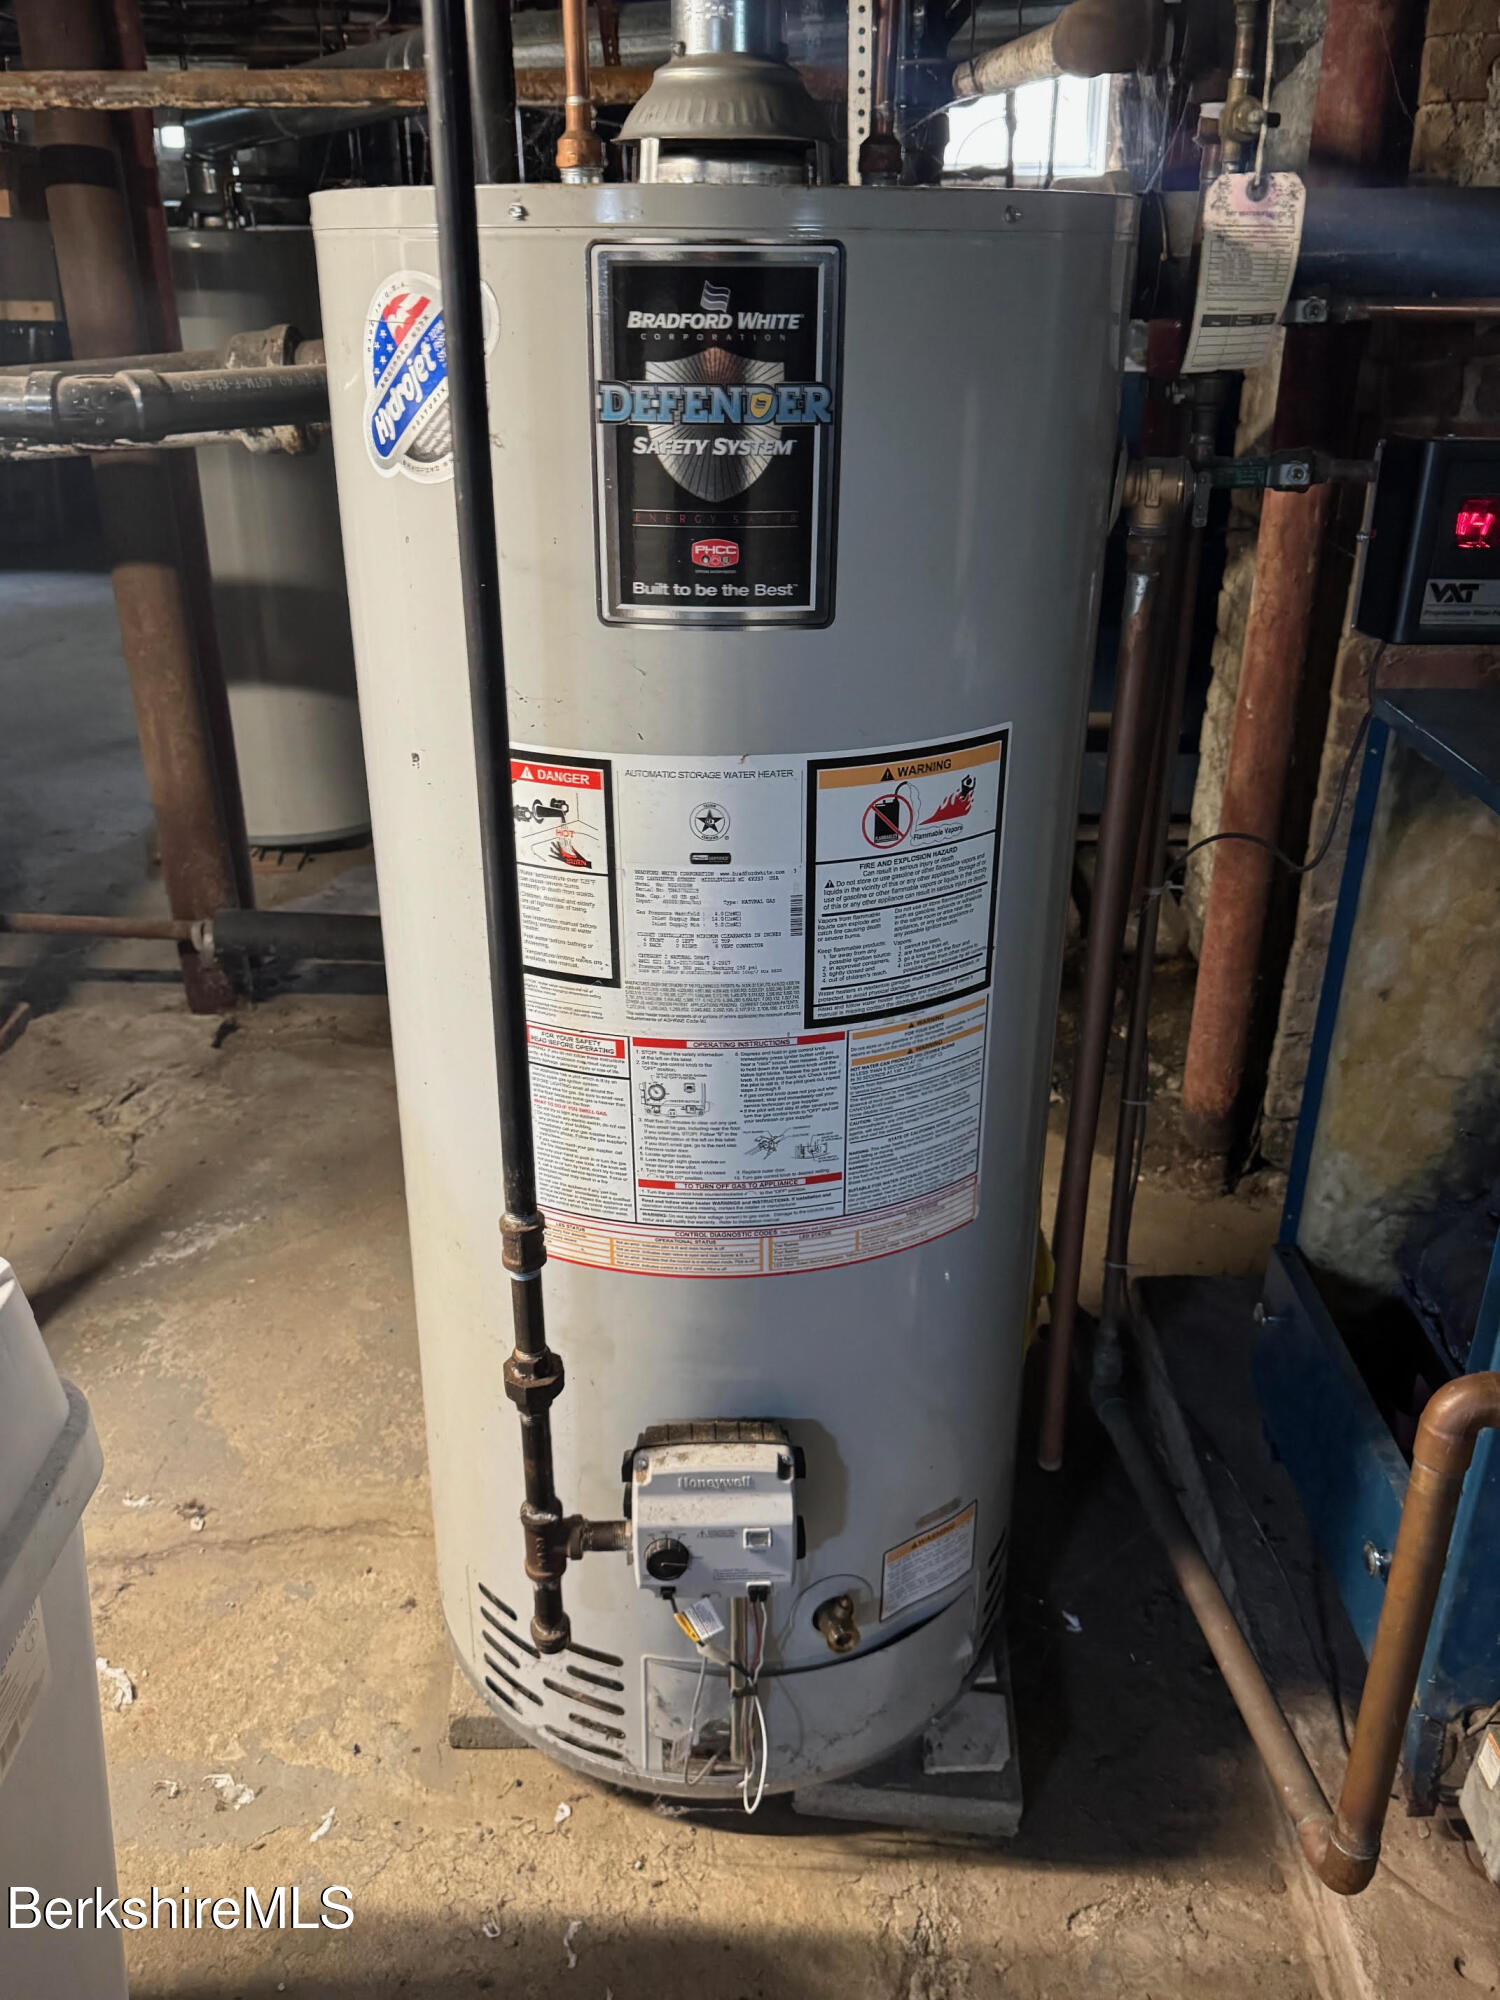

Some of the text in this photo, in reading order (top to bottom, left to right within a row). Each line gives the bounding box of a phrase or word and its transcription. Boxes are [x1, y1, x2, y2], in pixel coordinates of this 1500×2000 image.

[627, 311, 801, 330] BRADFORD WHITE
[640, 332, 786, 341] CORPORATION
[374, 342, 437, 446] Hydrojet
[599, 382, 832, 423] DEFENDER
[632, 437, 794, 456] SAFETY SYSTEM
[694, 545, 737, 555] PHCC
[632, 582, 794, 596] Built to be the Best
[1430, 583, 1479, 603] VXT
[625, 770, 794, 779] AUTOMATIC STORAGE WATER HEATER
[898, 759, 952, 777] WARNING
[537, 769, 590, 785] DANGER
[556, 829, 574, 838] HOT
[912, 829, 944, 841] Flammable
[944, 825, 963, 835] Vapors
[894, 852, 932, 864] EXPLOSION
[932, 846, 958, 857] HAZARD
[575, 1038, 600, 1046] SAFETY
[576, 1044, 615, 1054] OPERATING
[738, 1039, 790, 1048] INSTRUCTIONS
[759, 1179, 798, 1188] APPLIANCE
[677, 1476, 751, 1490] Honeywell
